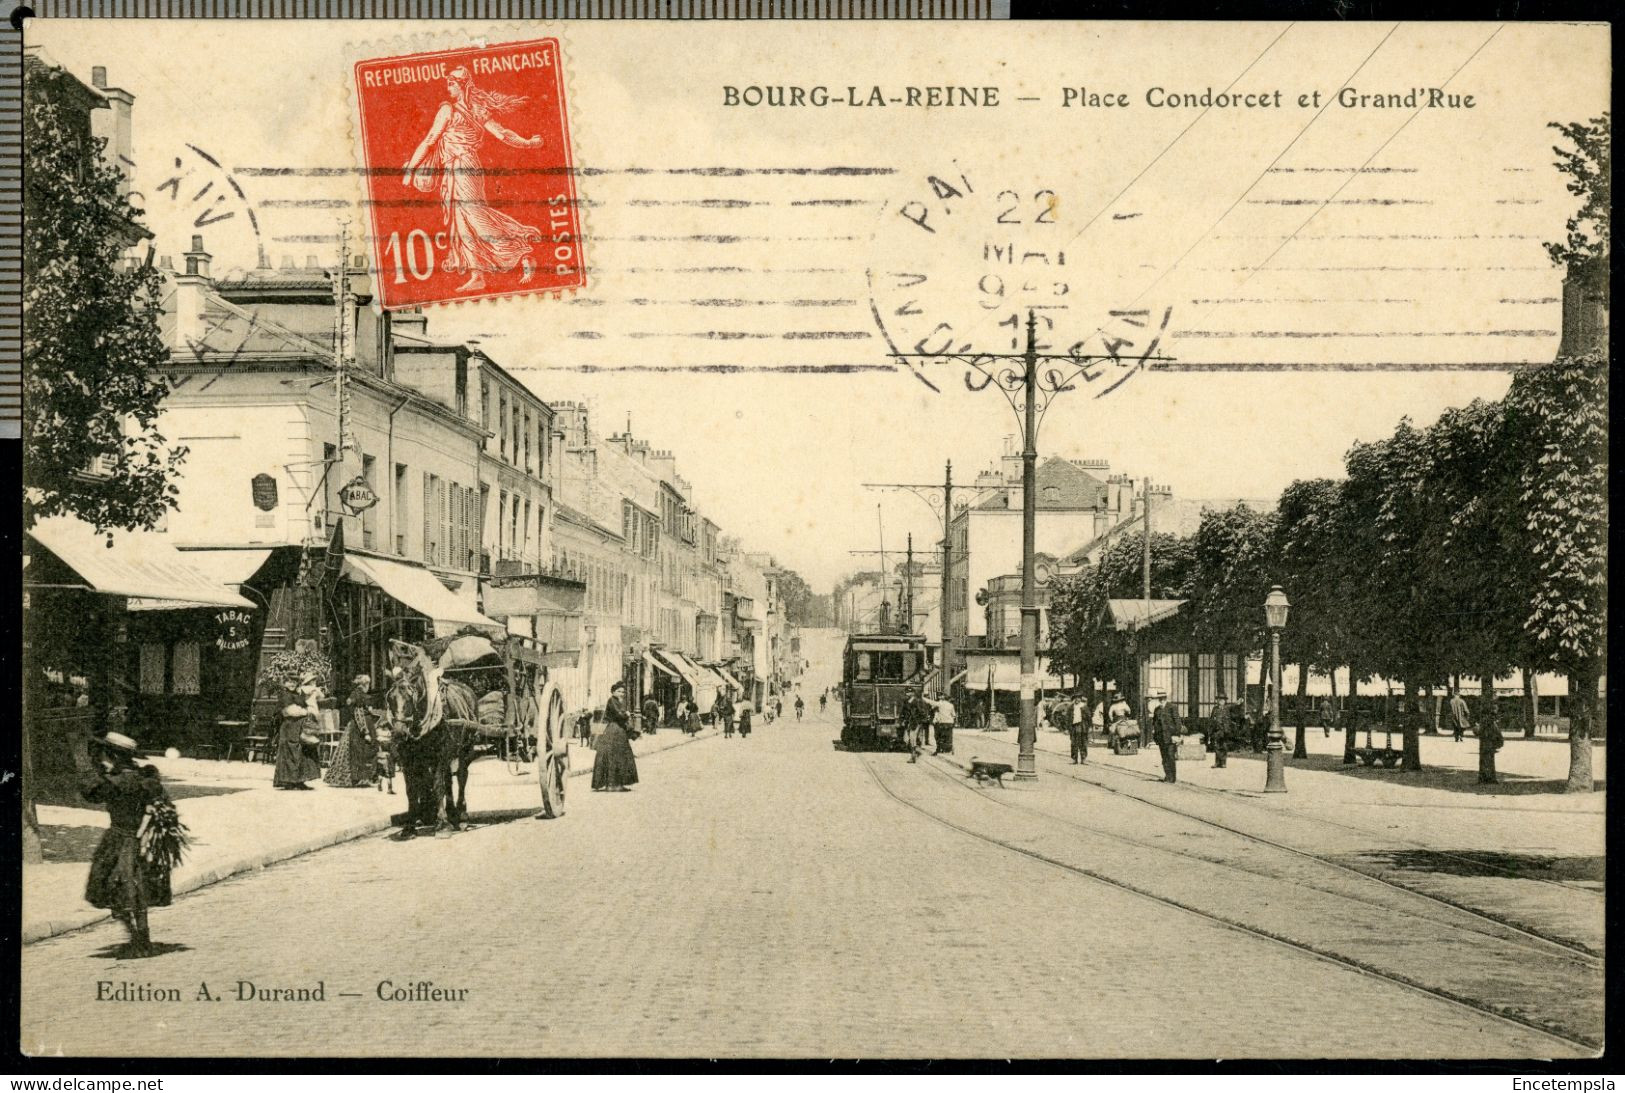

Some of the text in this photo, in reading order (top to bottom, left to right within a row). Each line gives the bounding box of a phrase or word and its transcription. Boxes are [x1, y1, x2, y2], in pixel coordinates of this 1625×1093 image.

[364, 49, 551, 88] REPUBLIQUE FRANÇAISE
[548, 193, 575, 276] POSTES
[345, 488, 372, 501] TABAC
[215, 610, 251, 624] TABAC
[229, 626, 236, 637] 5
